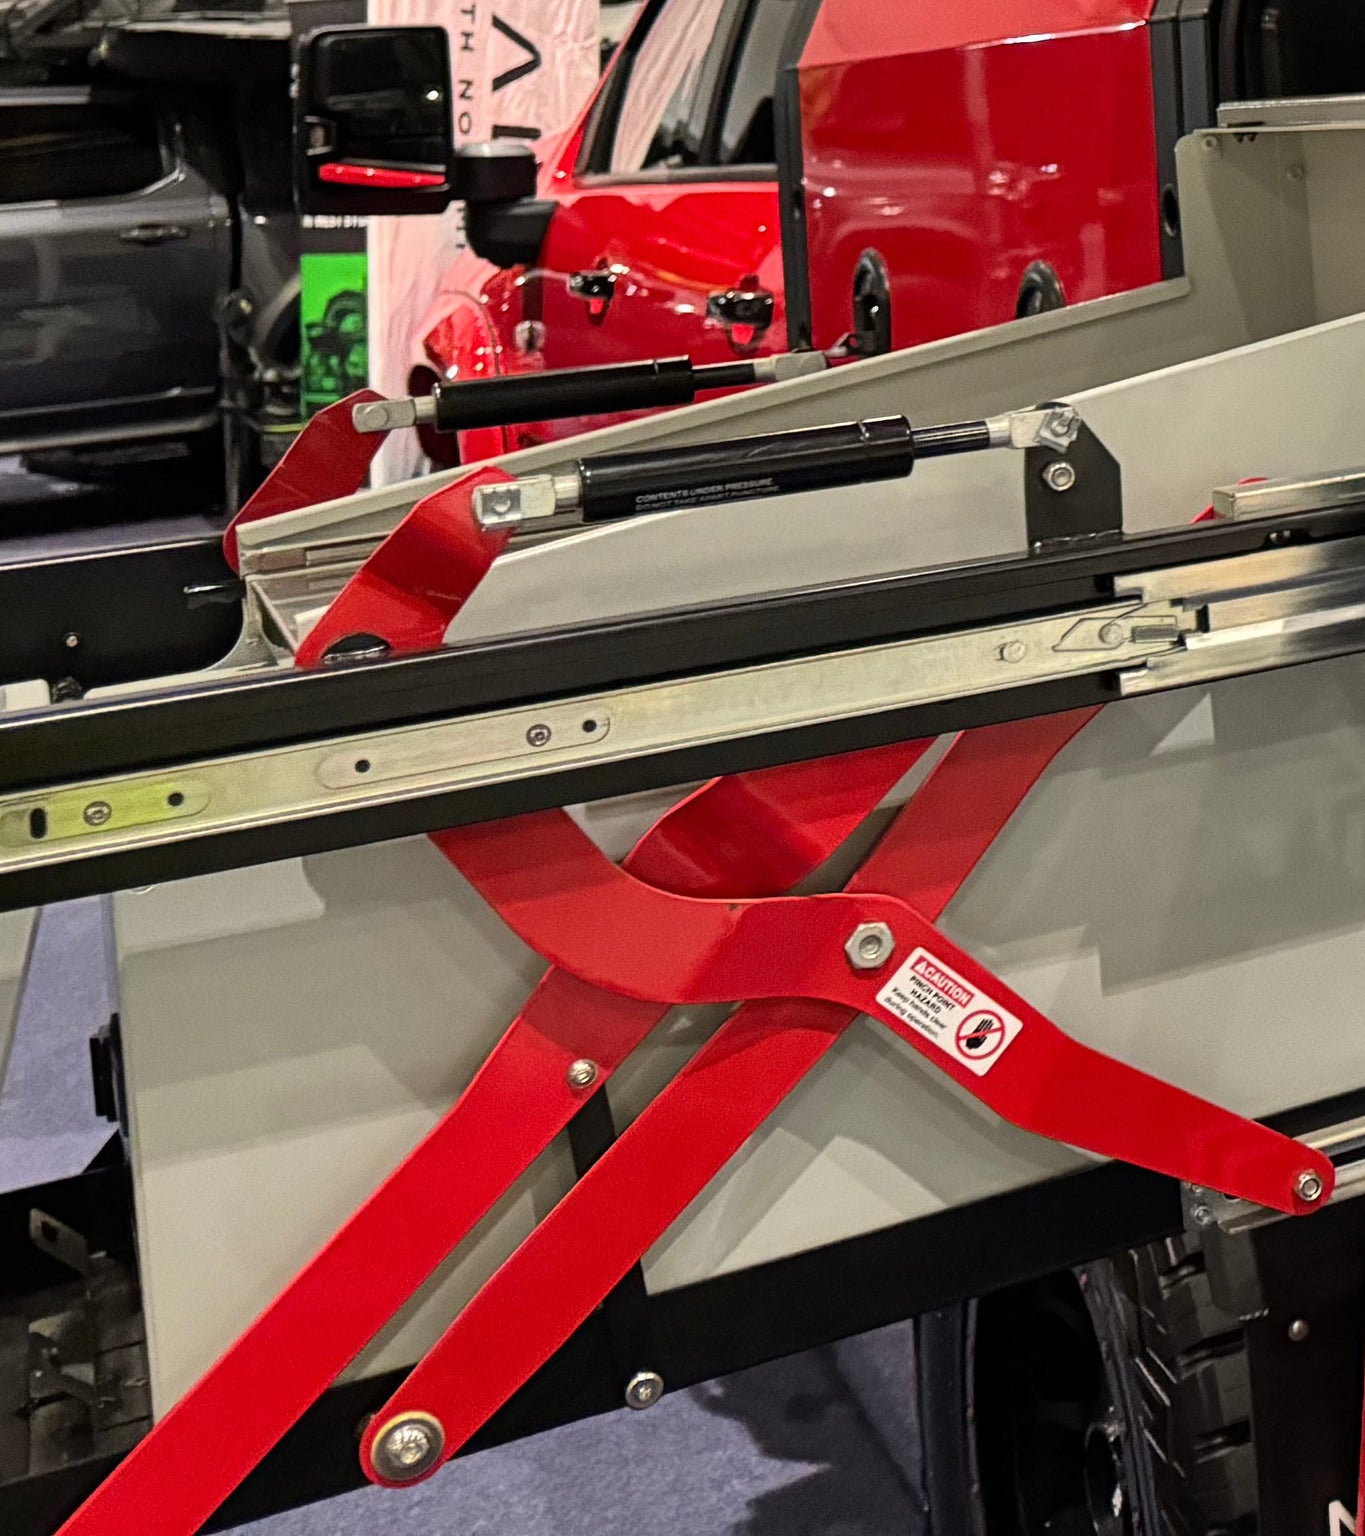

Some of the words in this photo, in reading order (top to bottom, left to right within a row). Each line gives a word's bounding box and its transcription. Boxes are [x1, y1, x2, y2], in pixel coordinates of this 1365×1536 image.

[457, 79, 474, 135] NO
[689, 484, 724, 496] UNDER
[725, 477, 773, 491] PRESSURE
[891, 986, 911, 1006] Keep
[908, 997, 930, 1020] hands
[909, 975, 933, 995] PINCH
[932, 990, 956, 1011] POINT
[910, 988, 942, 1015] HAZARD
[923, 968, 973, 1008] CAUTION
[883, 996, 906, 1016] during
